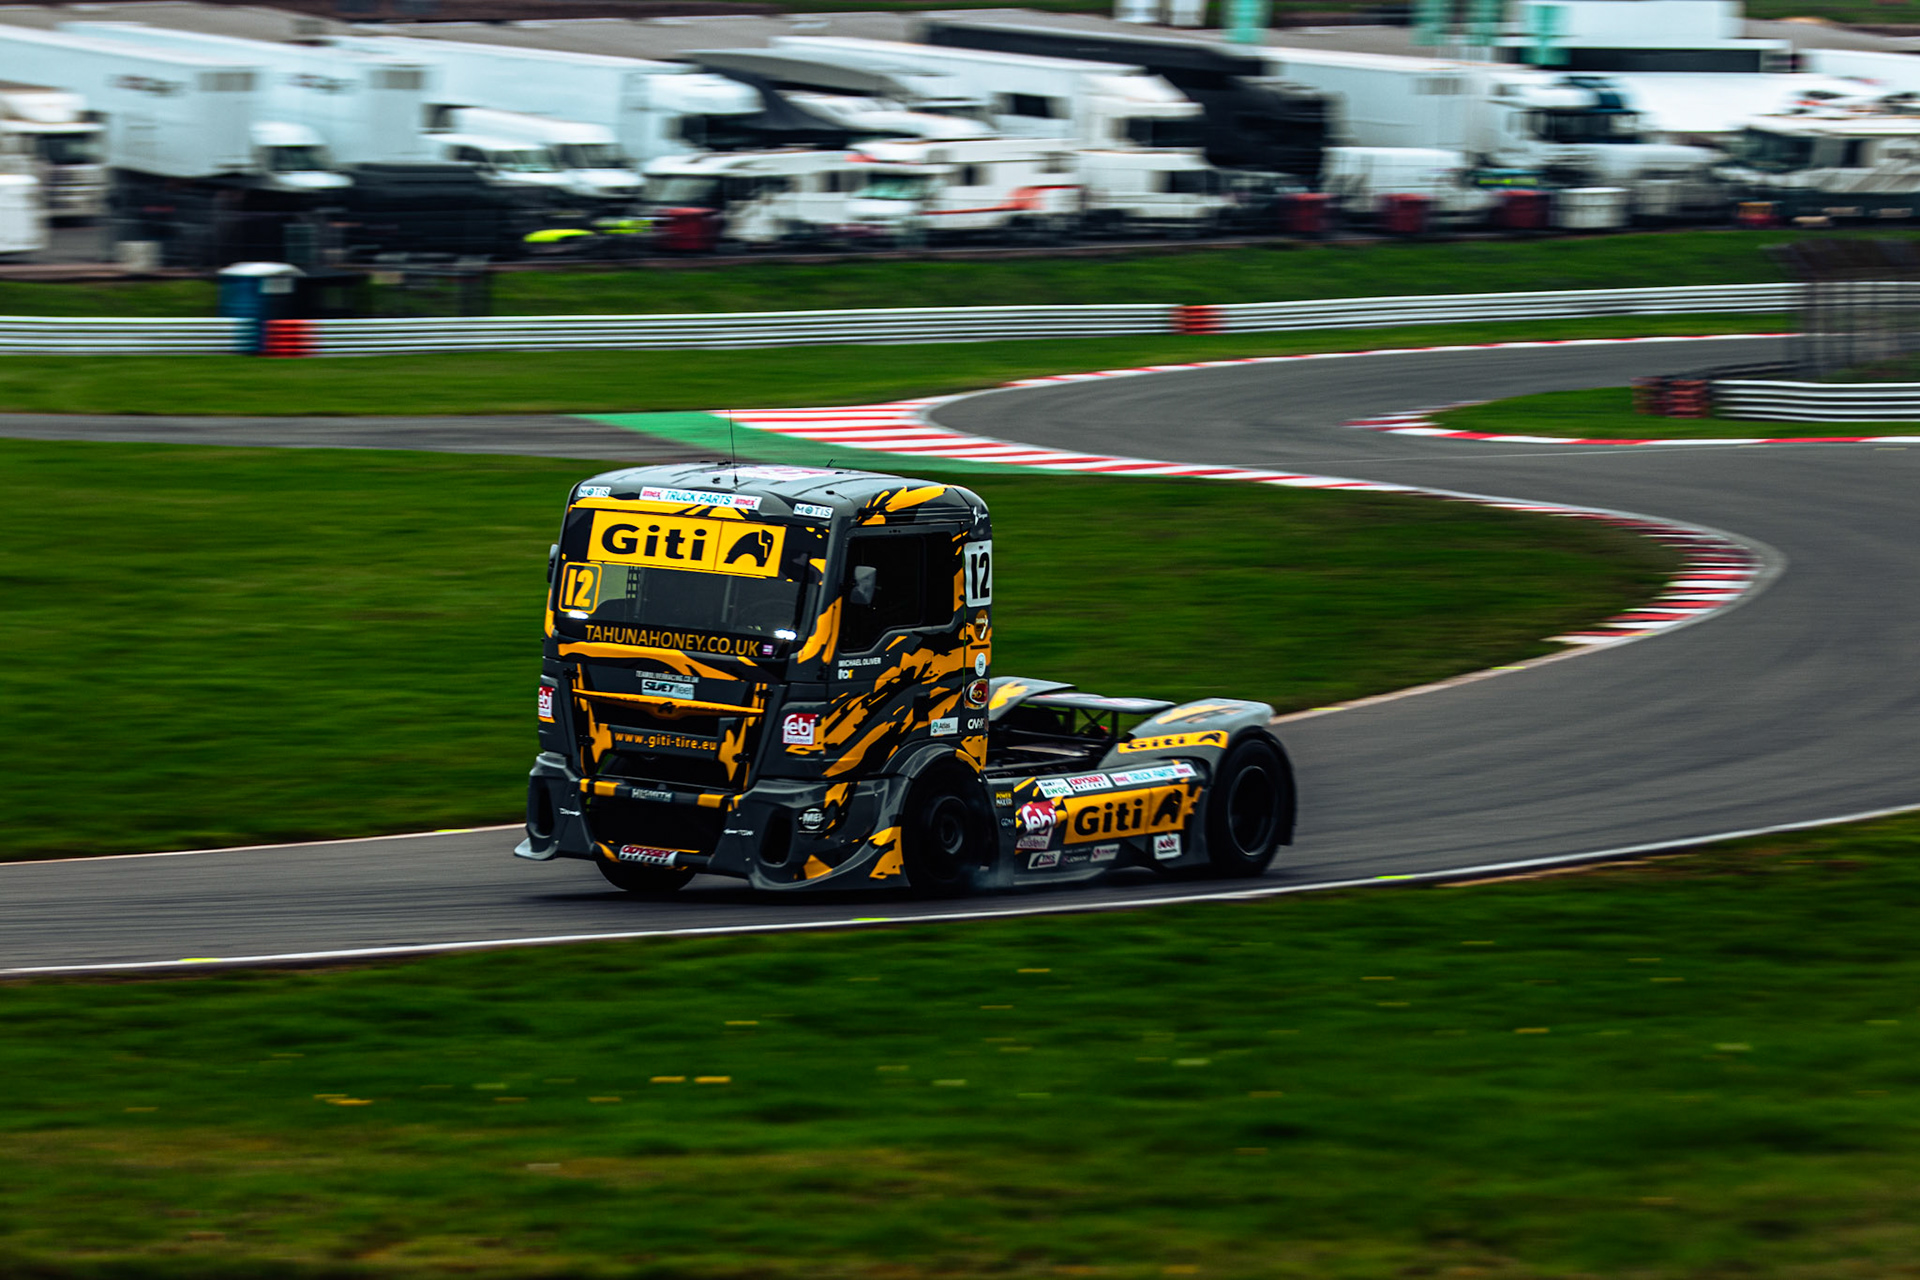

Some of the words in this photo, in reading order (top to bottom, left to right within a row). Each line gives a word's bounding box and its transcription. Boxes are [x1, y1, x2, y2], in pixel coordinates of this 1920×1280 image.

[664, 490, 698, 503] TRUCK
[698, 493, 733, 505] PARTS
[795, 504, 831, 517] MOTIS
[601, 523, 707, 561] Giti
[969, 551, 990, 600] 12
[565, 568, 594, 607] 12
[585, 624, 760, 657] TAHUNAHONEY.CO.UK
[782, 714, 815, 736] febi
[614, 732, 718, 751] www.giti-tire.eu
[1126, 736, 1185, 749] Giti
[1070, 775, 1104, 786] ODYSSEY
[1022, 804, 1057, 832] febi
[1075, 798, 1143, 836] Giti
[622, 845, 673, 859] ODYSSEY
